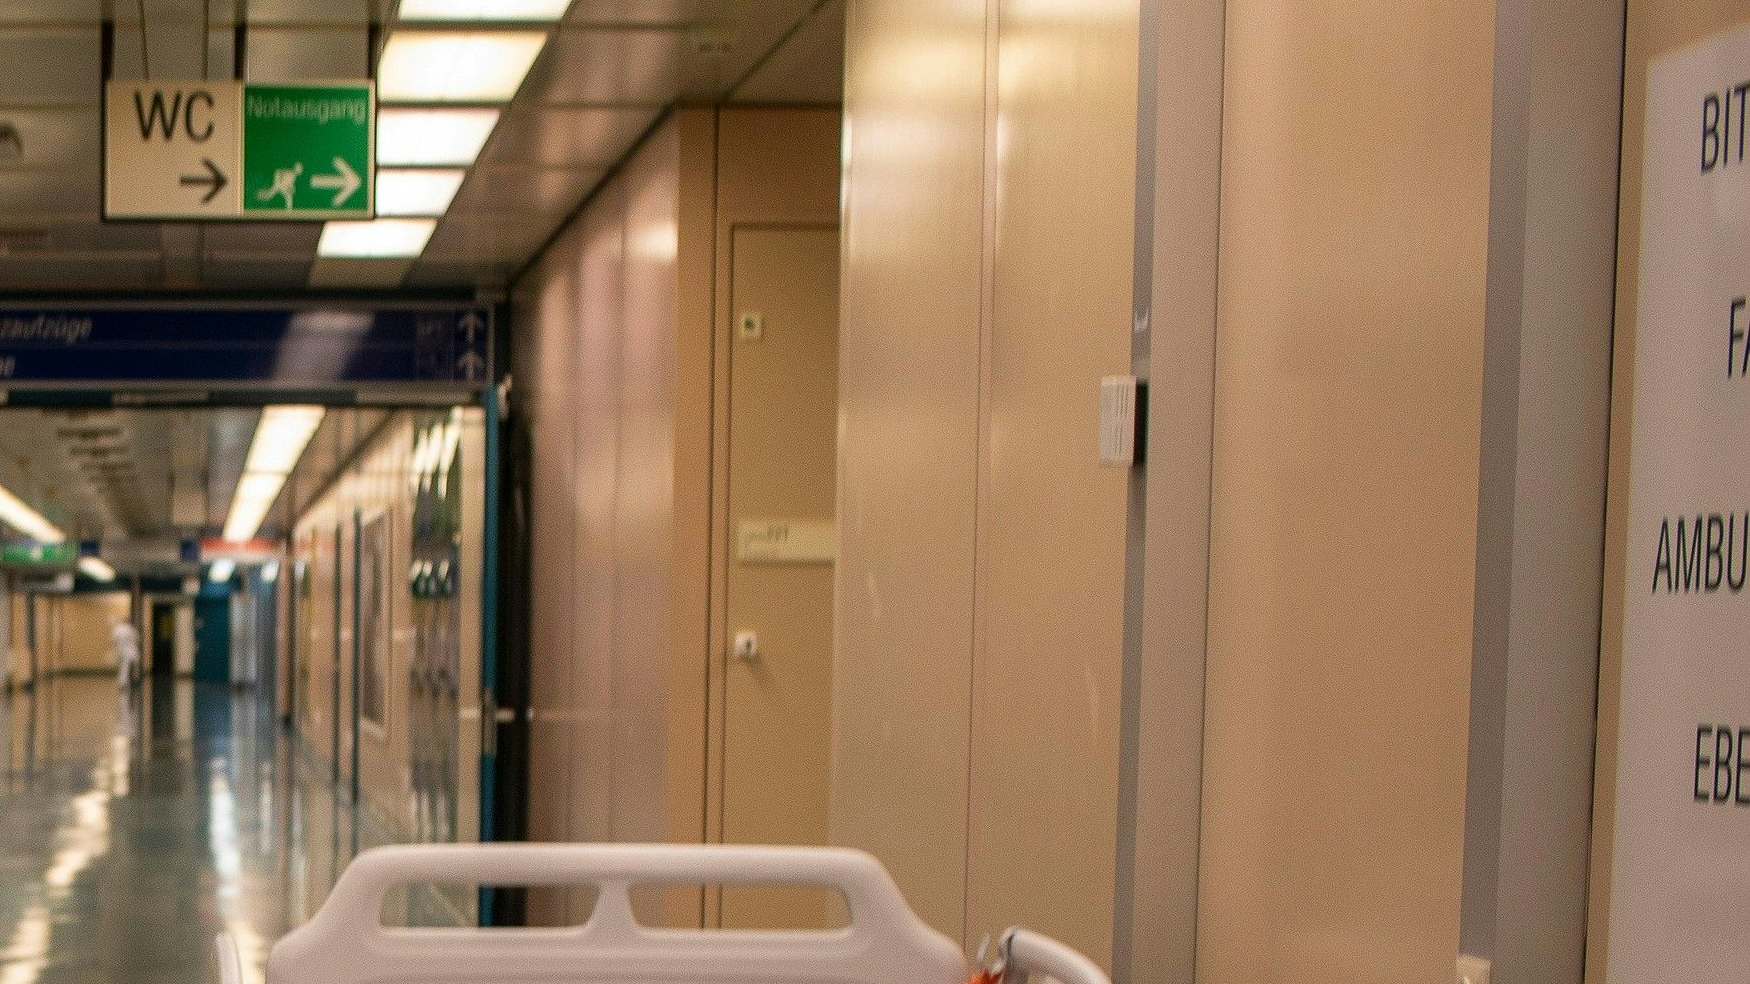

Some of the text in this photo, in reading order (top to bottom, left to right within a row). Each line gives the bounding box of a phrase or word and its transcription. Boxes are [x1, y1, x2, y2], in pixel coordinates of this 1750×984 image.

[134, 89, 215, 142] WC
[248, 94, 366, 125] Notausgang
[1651, 510, 1750, 594] AMBU
[1693, 723, 1750, 805] EBE
